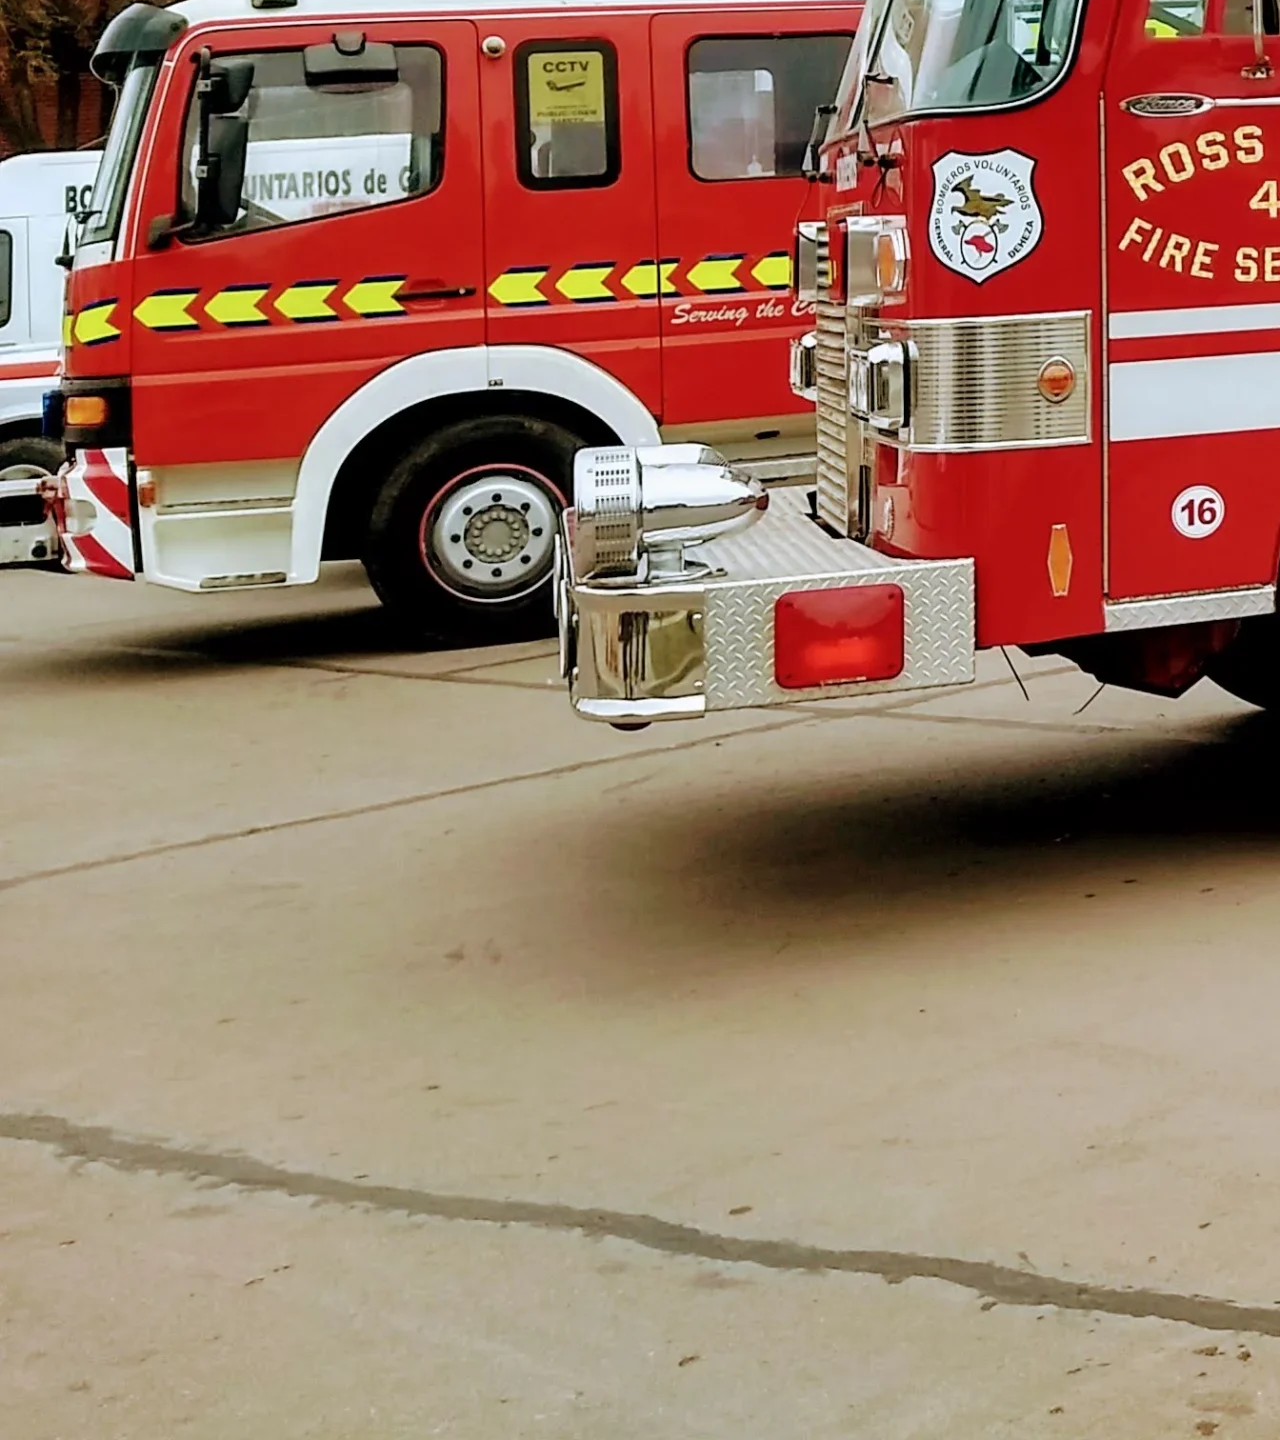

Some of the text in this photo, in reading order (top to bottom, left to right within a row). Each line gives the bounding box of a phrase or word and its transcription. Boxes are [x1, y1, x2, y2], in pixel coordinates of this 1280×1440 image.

[542, 60, 590, 73] CCTV
[363, 169, 388, 194] de
[1121, 125, 1265, 202] ROSS
[935, 160, 1031, 214] BOMBEROS VOLUNTARIOS
[934, 218, 1035, 262] GENERAL DEHEZA
[1118, 216, 1220, 279] FIRE
[671, 303, 749, 327] Serving
[755, 297, 785, 319] the
[1180, 497, 1217, 526] 16
